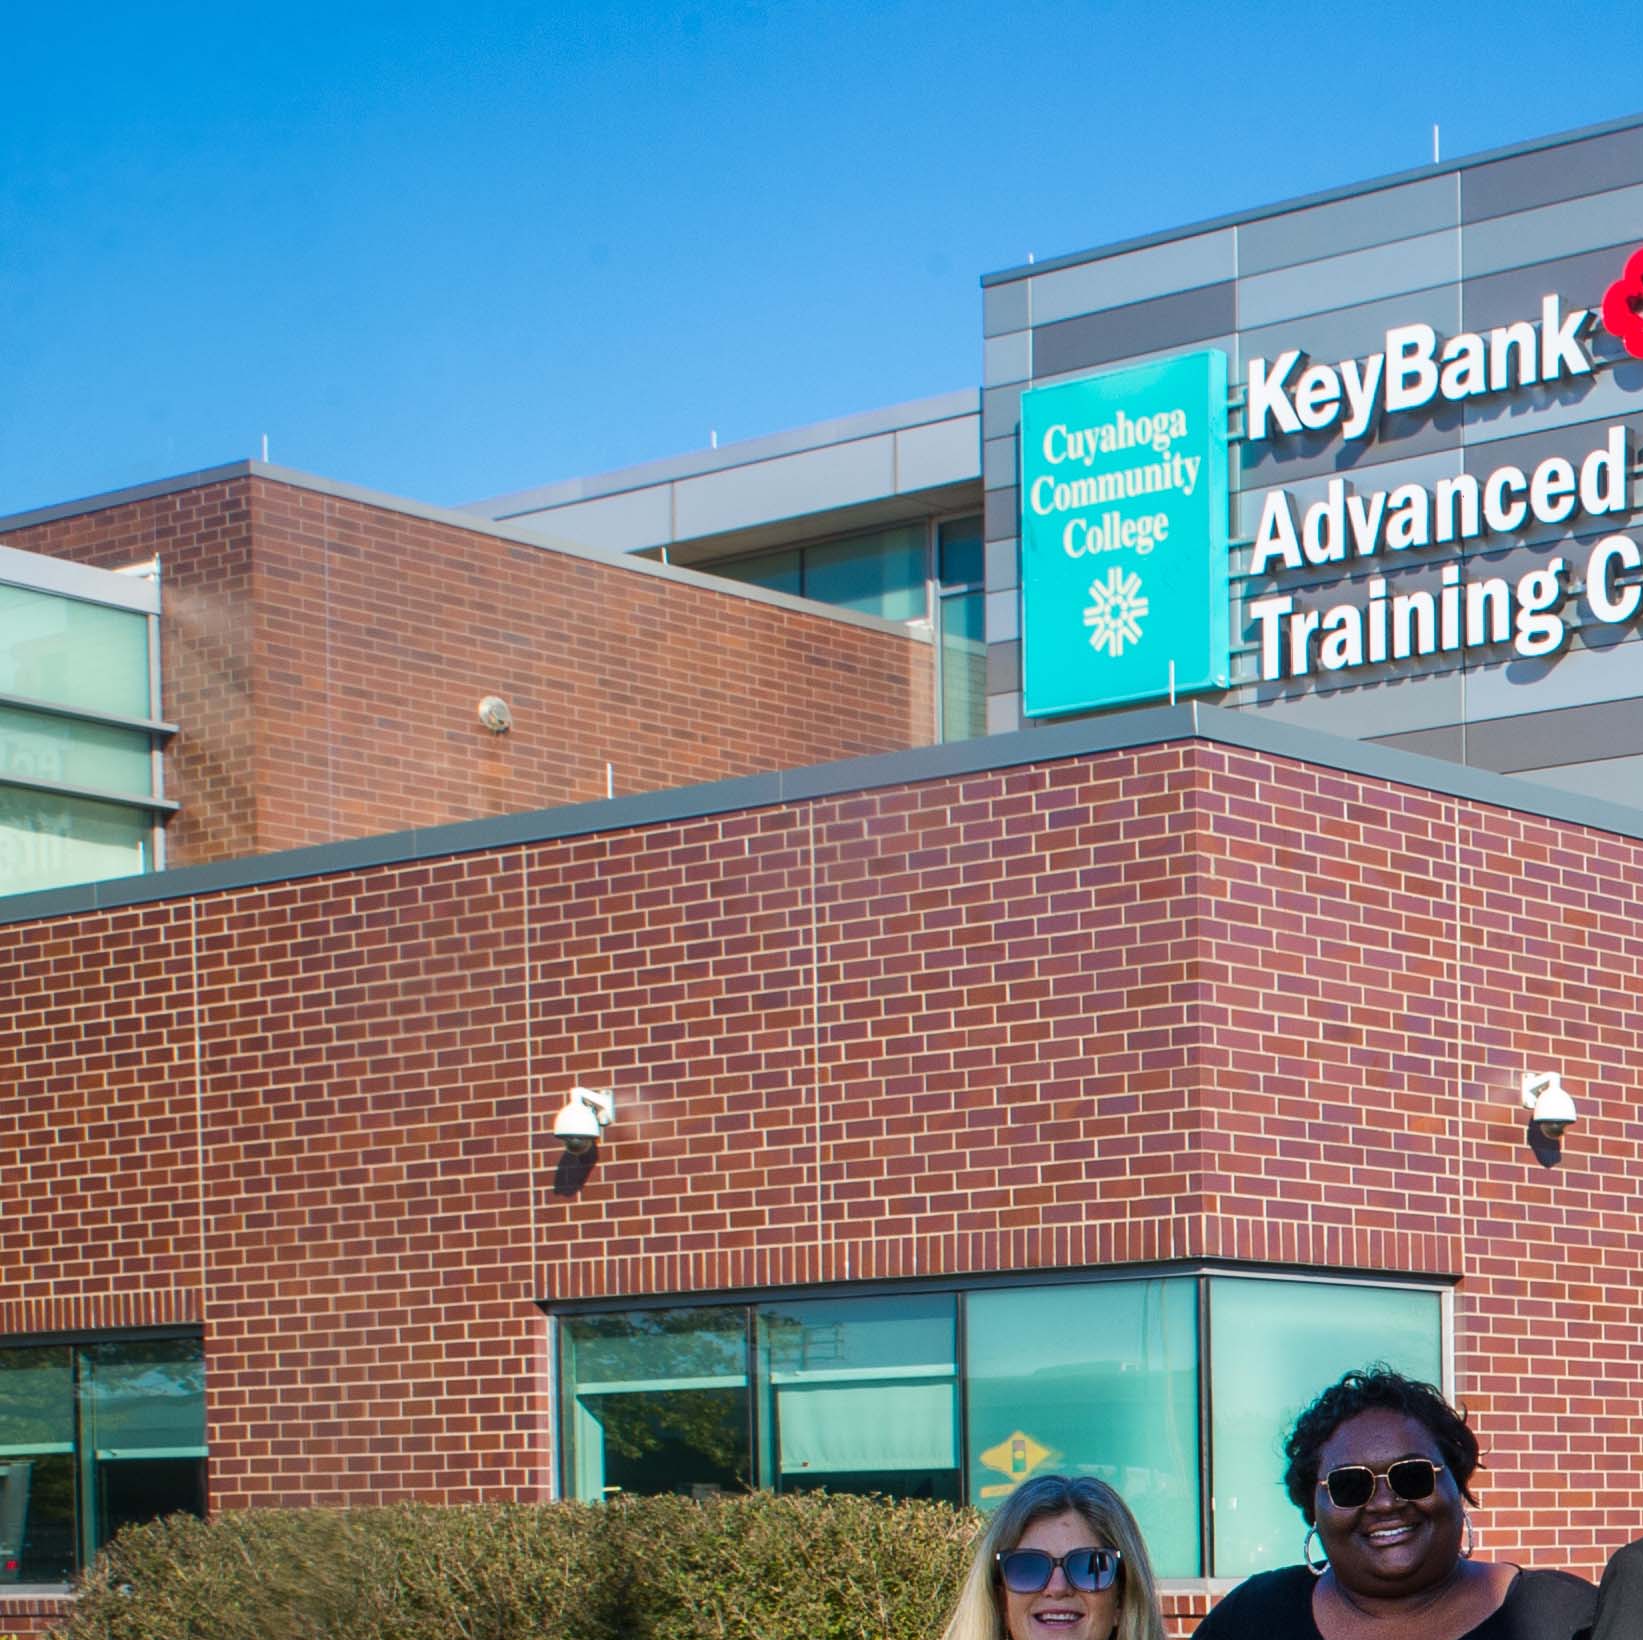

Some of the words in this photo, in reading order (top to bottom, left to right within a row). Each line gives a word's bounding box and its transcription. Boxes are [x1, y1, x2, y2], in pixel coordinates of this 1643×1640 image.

[1248, 293, 1592, 441] KeyBank
[1030, 451, 1201, 515] Community
[1043, 408, 1188, 466] Cuyahoga
[1062, 510, 1169, 558] College
[1249, 424, 1628, 576] Advanced
[1250, 557, 1565, 681] Training
